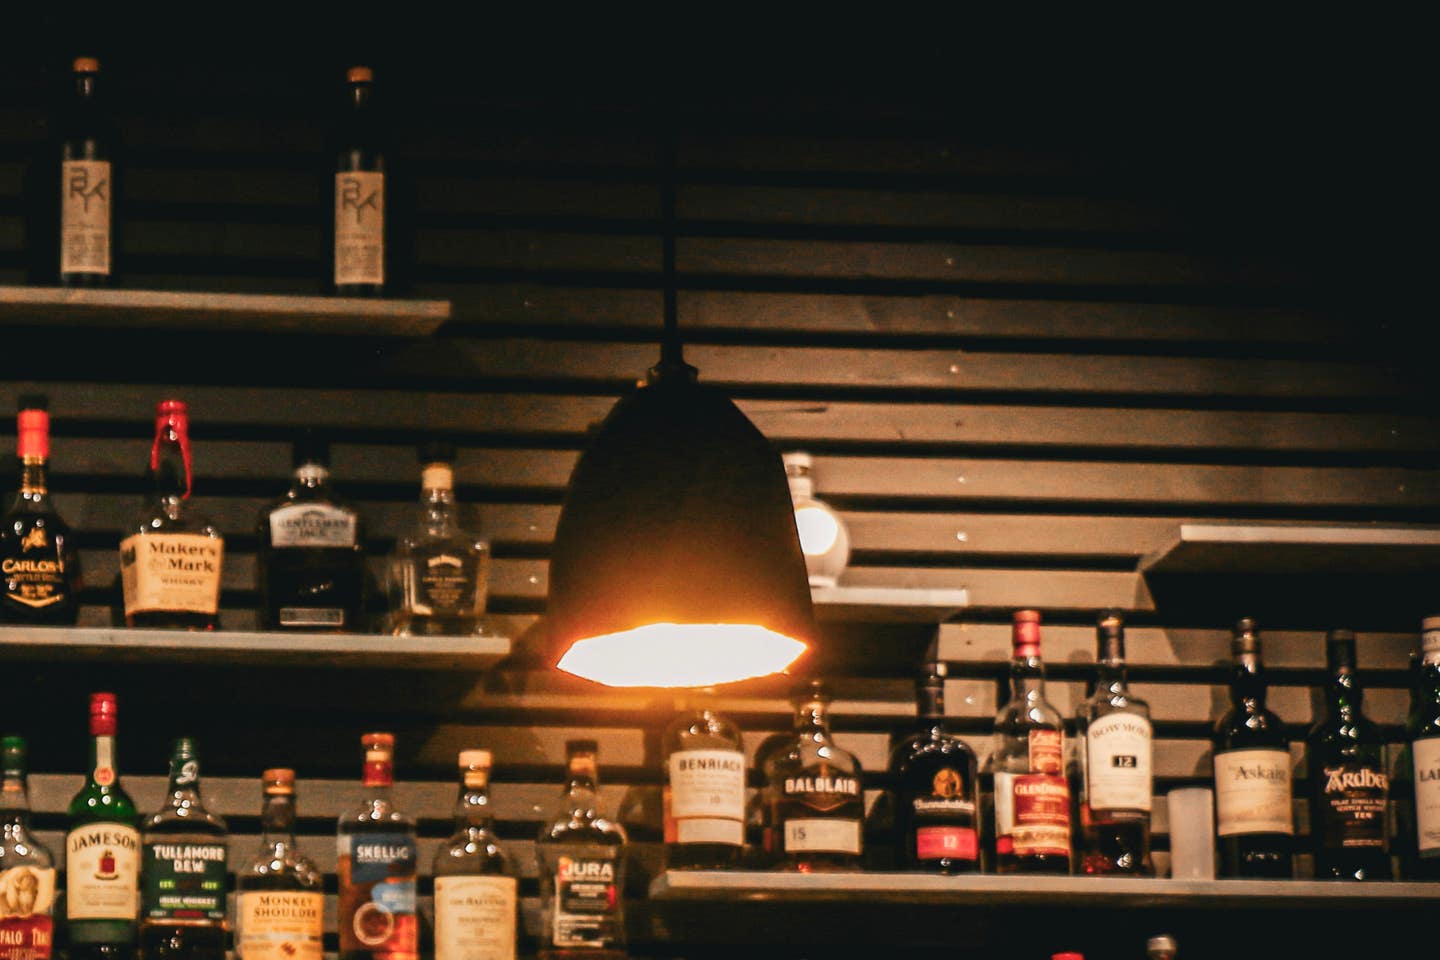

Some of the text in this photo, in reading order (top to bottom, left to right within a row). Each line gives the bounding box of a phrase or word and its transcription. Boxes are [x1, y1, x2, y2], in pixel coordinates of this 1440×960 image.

[149, 542, 217, 557] Maker's
[167, 558, 215, 573] Mark
[1117, 755, 1134, 768] 12
[785, 777, 857, 795] BALBLAIR
[791, 826, 806, 842] 15
[71, 832, 137, 853] JAMESON
[152, 844, 225, 862] TULLAMORE
[561, 862, 614, 876] JURA
[259, 896, 313, 907] MONKEY
